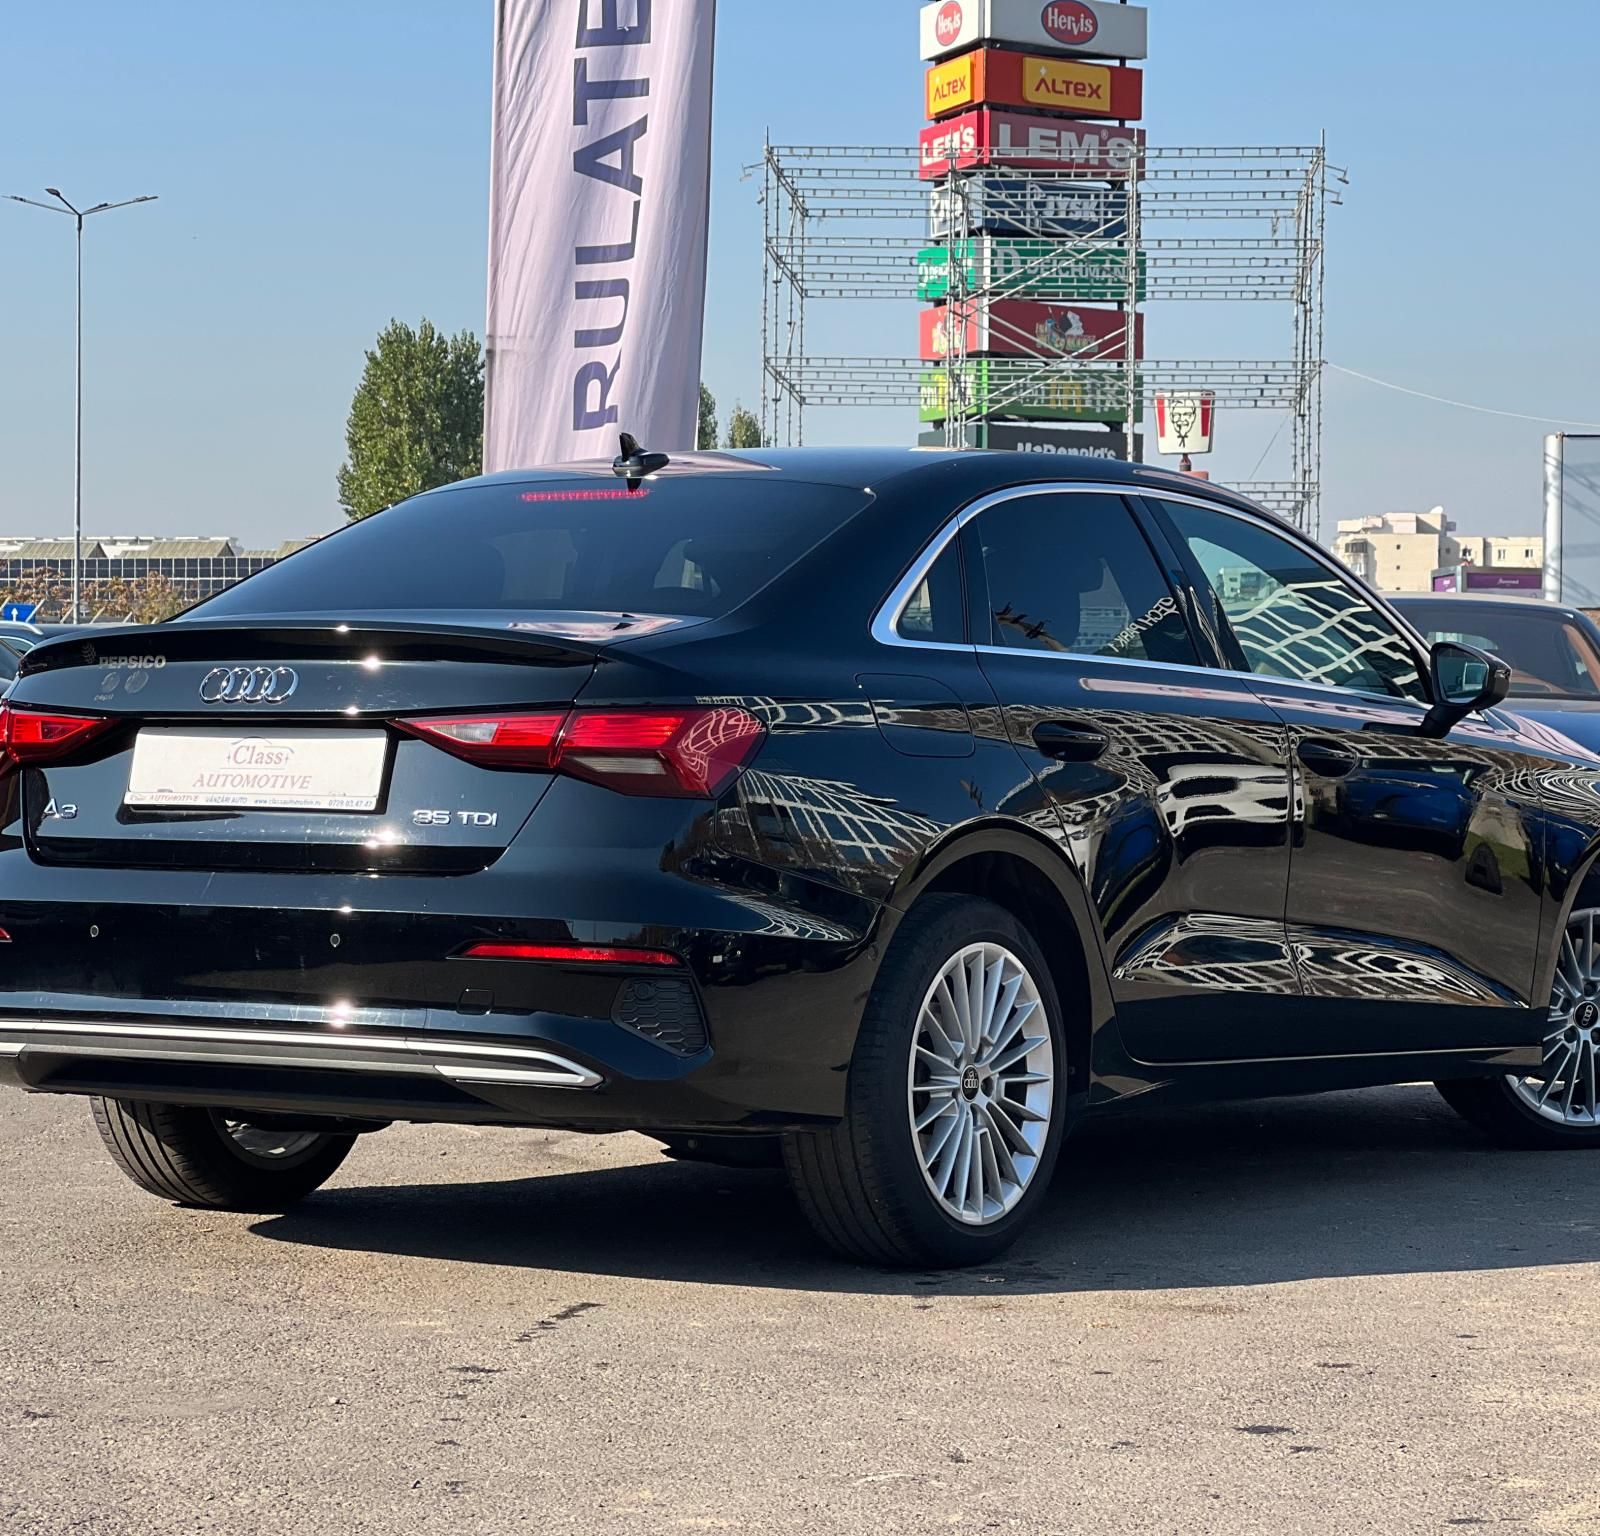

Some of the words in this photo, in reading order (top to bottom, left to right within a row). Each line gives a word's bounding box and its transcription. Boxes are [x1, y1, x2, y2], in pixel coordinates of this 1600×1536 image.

[937, 14, 961, 36] Hervis
[1047, 7, 1094, 36] Hervis
[98, 655, 167, 669] PEPSICO
[231, 745, 283, 764] Class
[192, 773, 313, 789] AUTOMOTIVE
[43, 798, 78, 820] A3
[413, 809, 451, 826] 35
[457, 811, 498, 827] TDI
